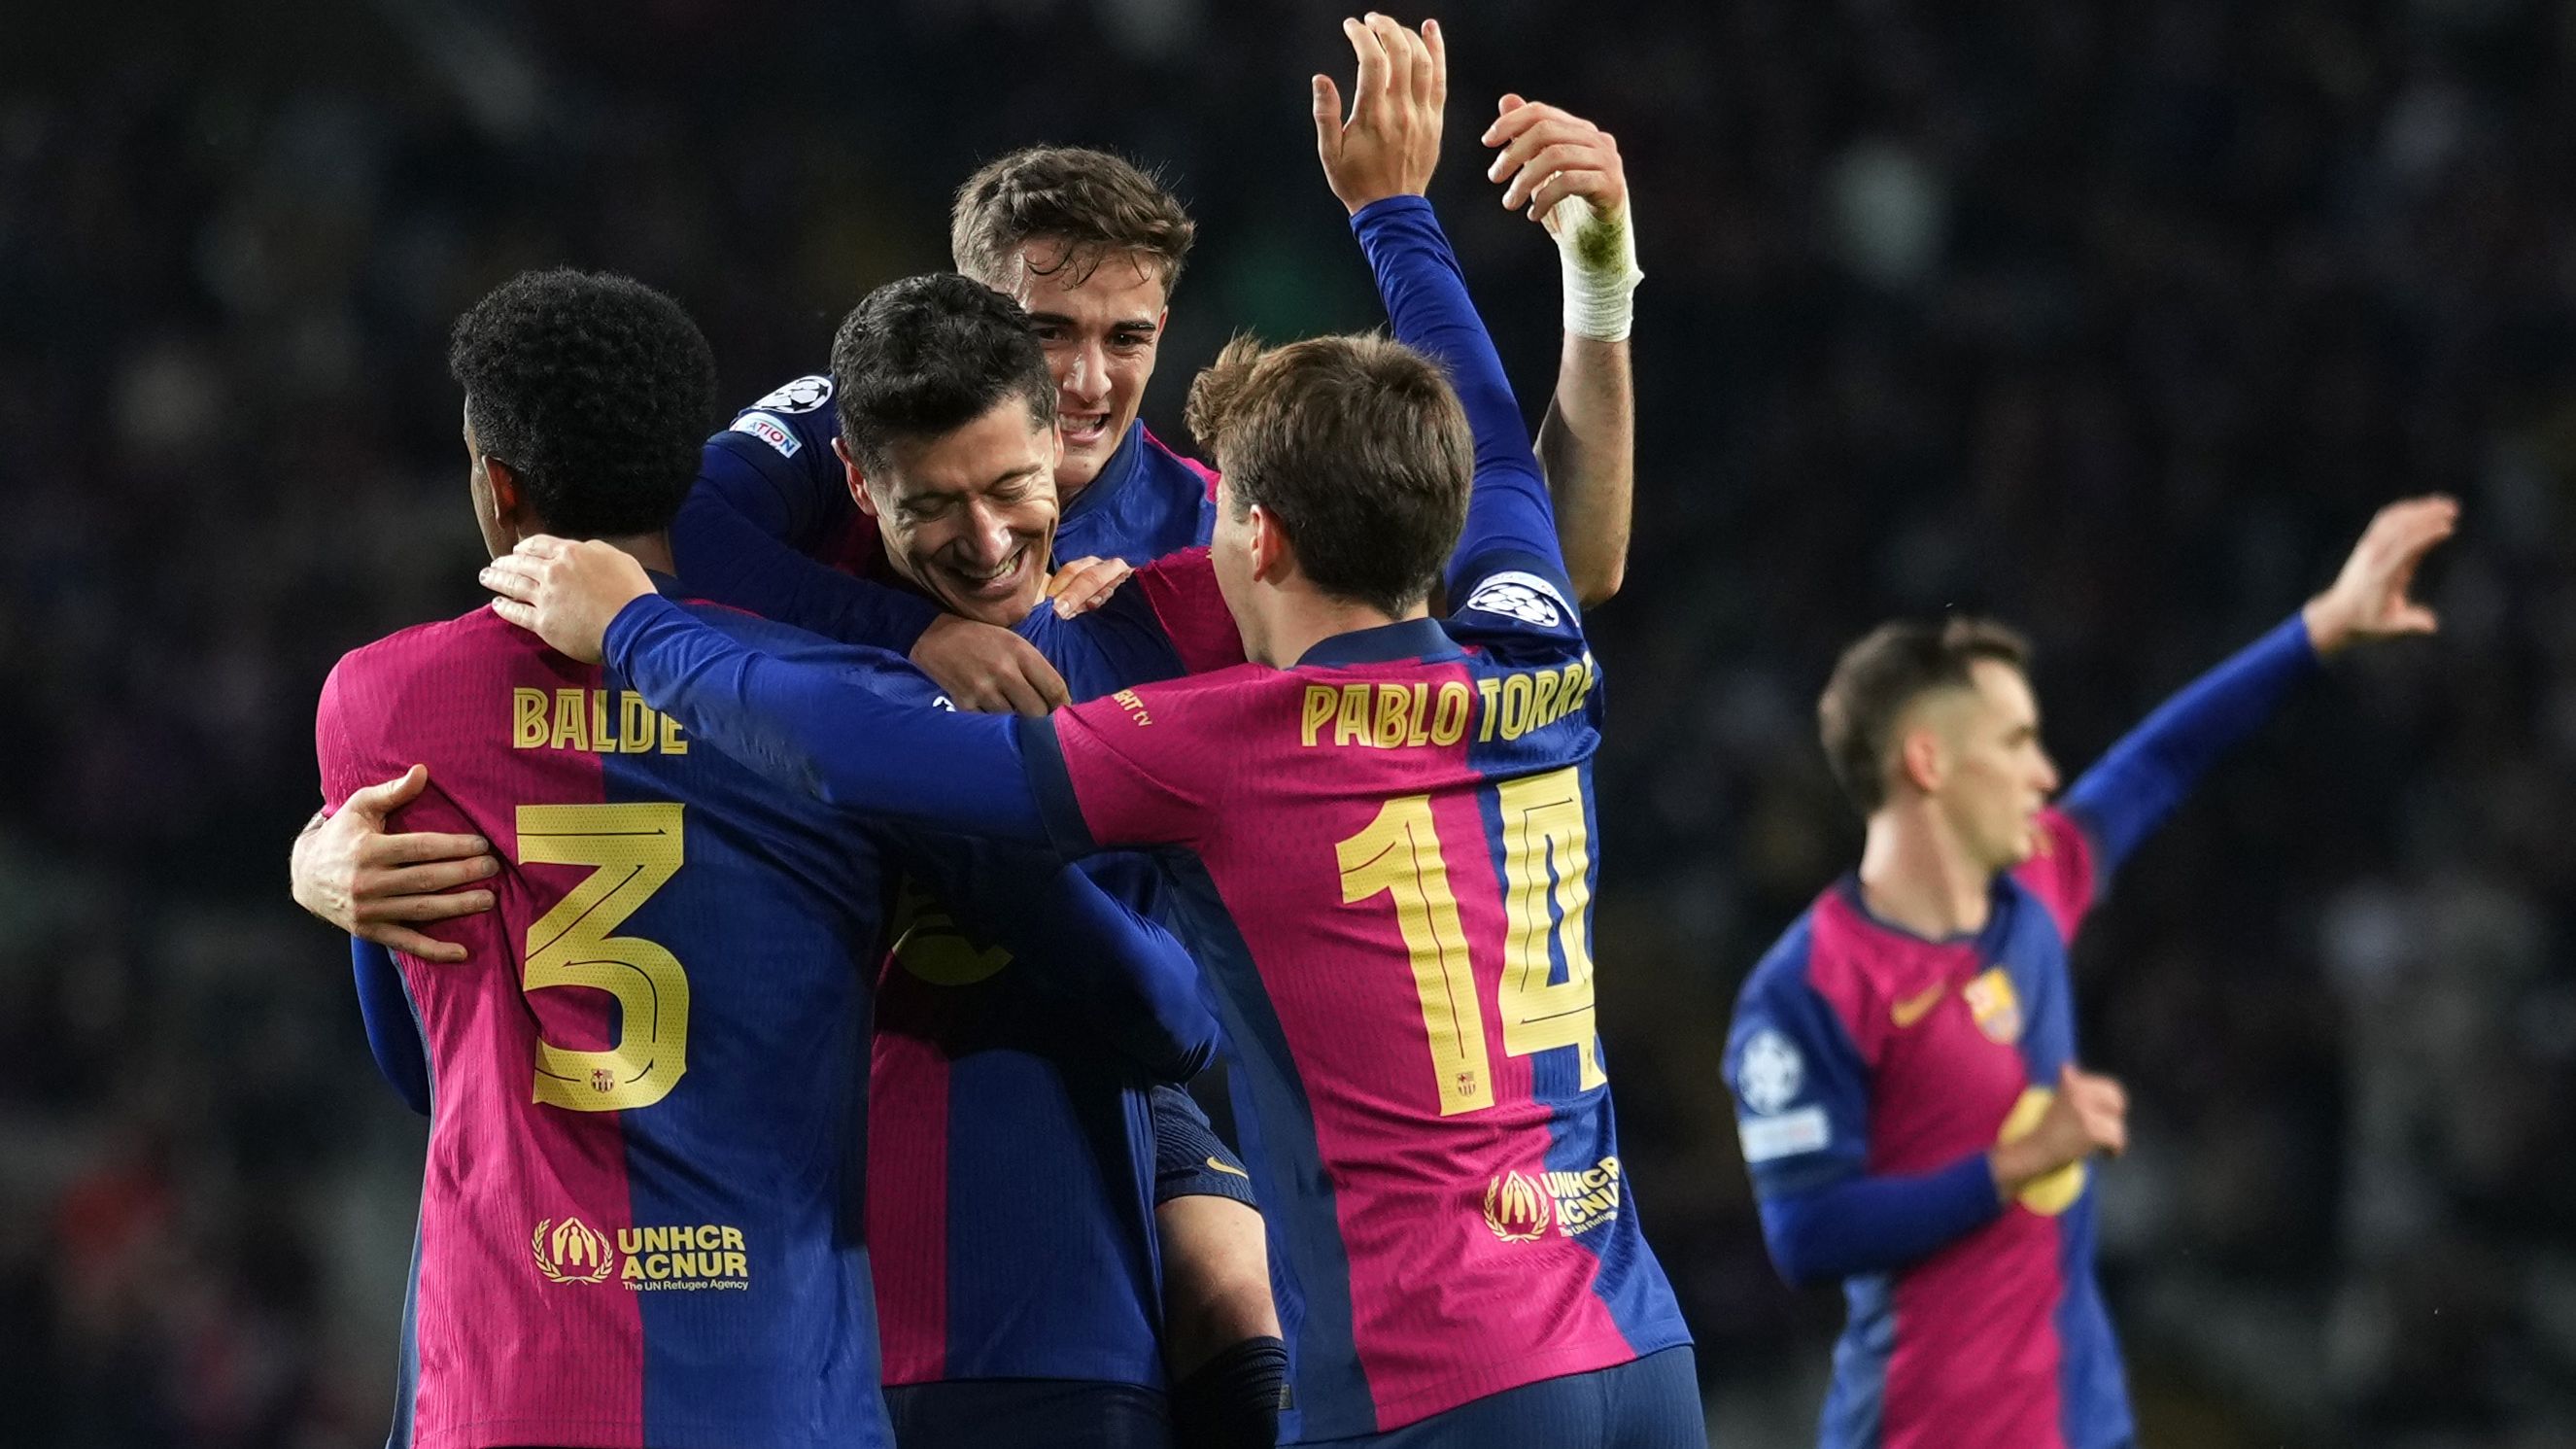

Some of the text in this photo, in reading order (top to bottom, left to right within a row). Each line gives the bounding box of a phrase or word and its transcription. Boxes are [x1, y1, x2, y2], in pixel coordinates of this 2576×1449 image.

[513, 687, 688, 755] BALDE
[1301, 650, 1594, 748] PABLO TORRE
[515, 803, 689, 1112] 3
[1335, 766, 1607, 1117] 14
[1539, 1156, 1620, 1199] UNHCR
[1556, 1181, 1620, 1226] ACNU
[617, 1225, 746, 1254] UNHCR
[620, 1251, 748, 1280] ACNUR
[622, 1279, 749, 1291] The UN Refugee Agency
